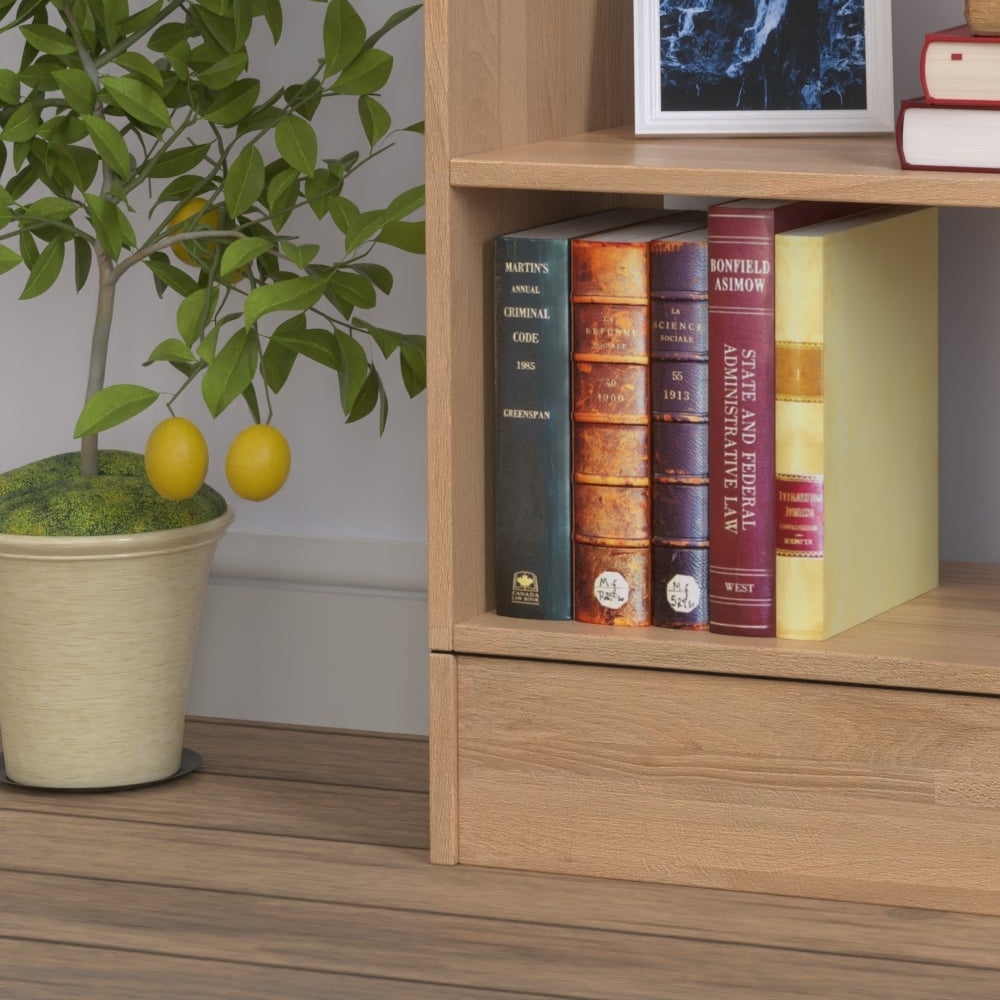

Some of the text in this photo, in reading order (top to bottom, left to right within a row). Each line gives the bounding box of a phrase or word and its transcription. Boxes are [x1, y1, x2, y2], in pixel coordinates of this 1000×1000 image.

[505, 262, 549, 274] MARTIN'S
[710, 259, 771, 275] BONFIELD
[511, 285, 540, 294] ANNUAL
[714, 277, 765, 293] ASIMOW
[504, 307, 550, 319] CRIMINAL
[652, 321, 703, 331] SCIENCE
[512, 332, 540, 344] CODE
[660, 335, 695, 343] SOCIALE
[516, 361, 536, 370] 1985
[671, 371, 684, 381] 55
[663, 390, 690, 401] 1913
[503, 408, 550, 420] GREENSPAN
[723, 343, 738, 535] ADMINISTRATIVE LAW
[741, 349, 757, 531] STATE AND FEDERAL
[724, 582, 754, 594] WEST
